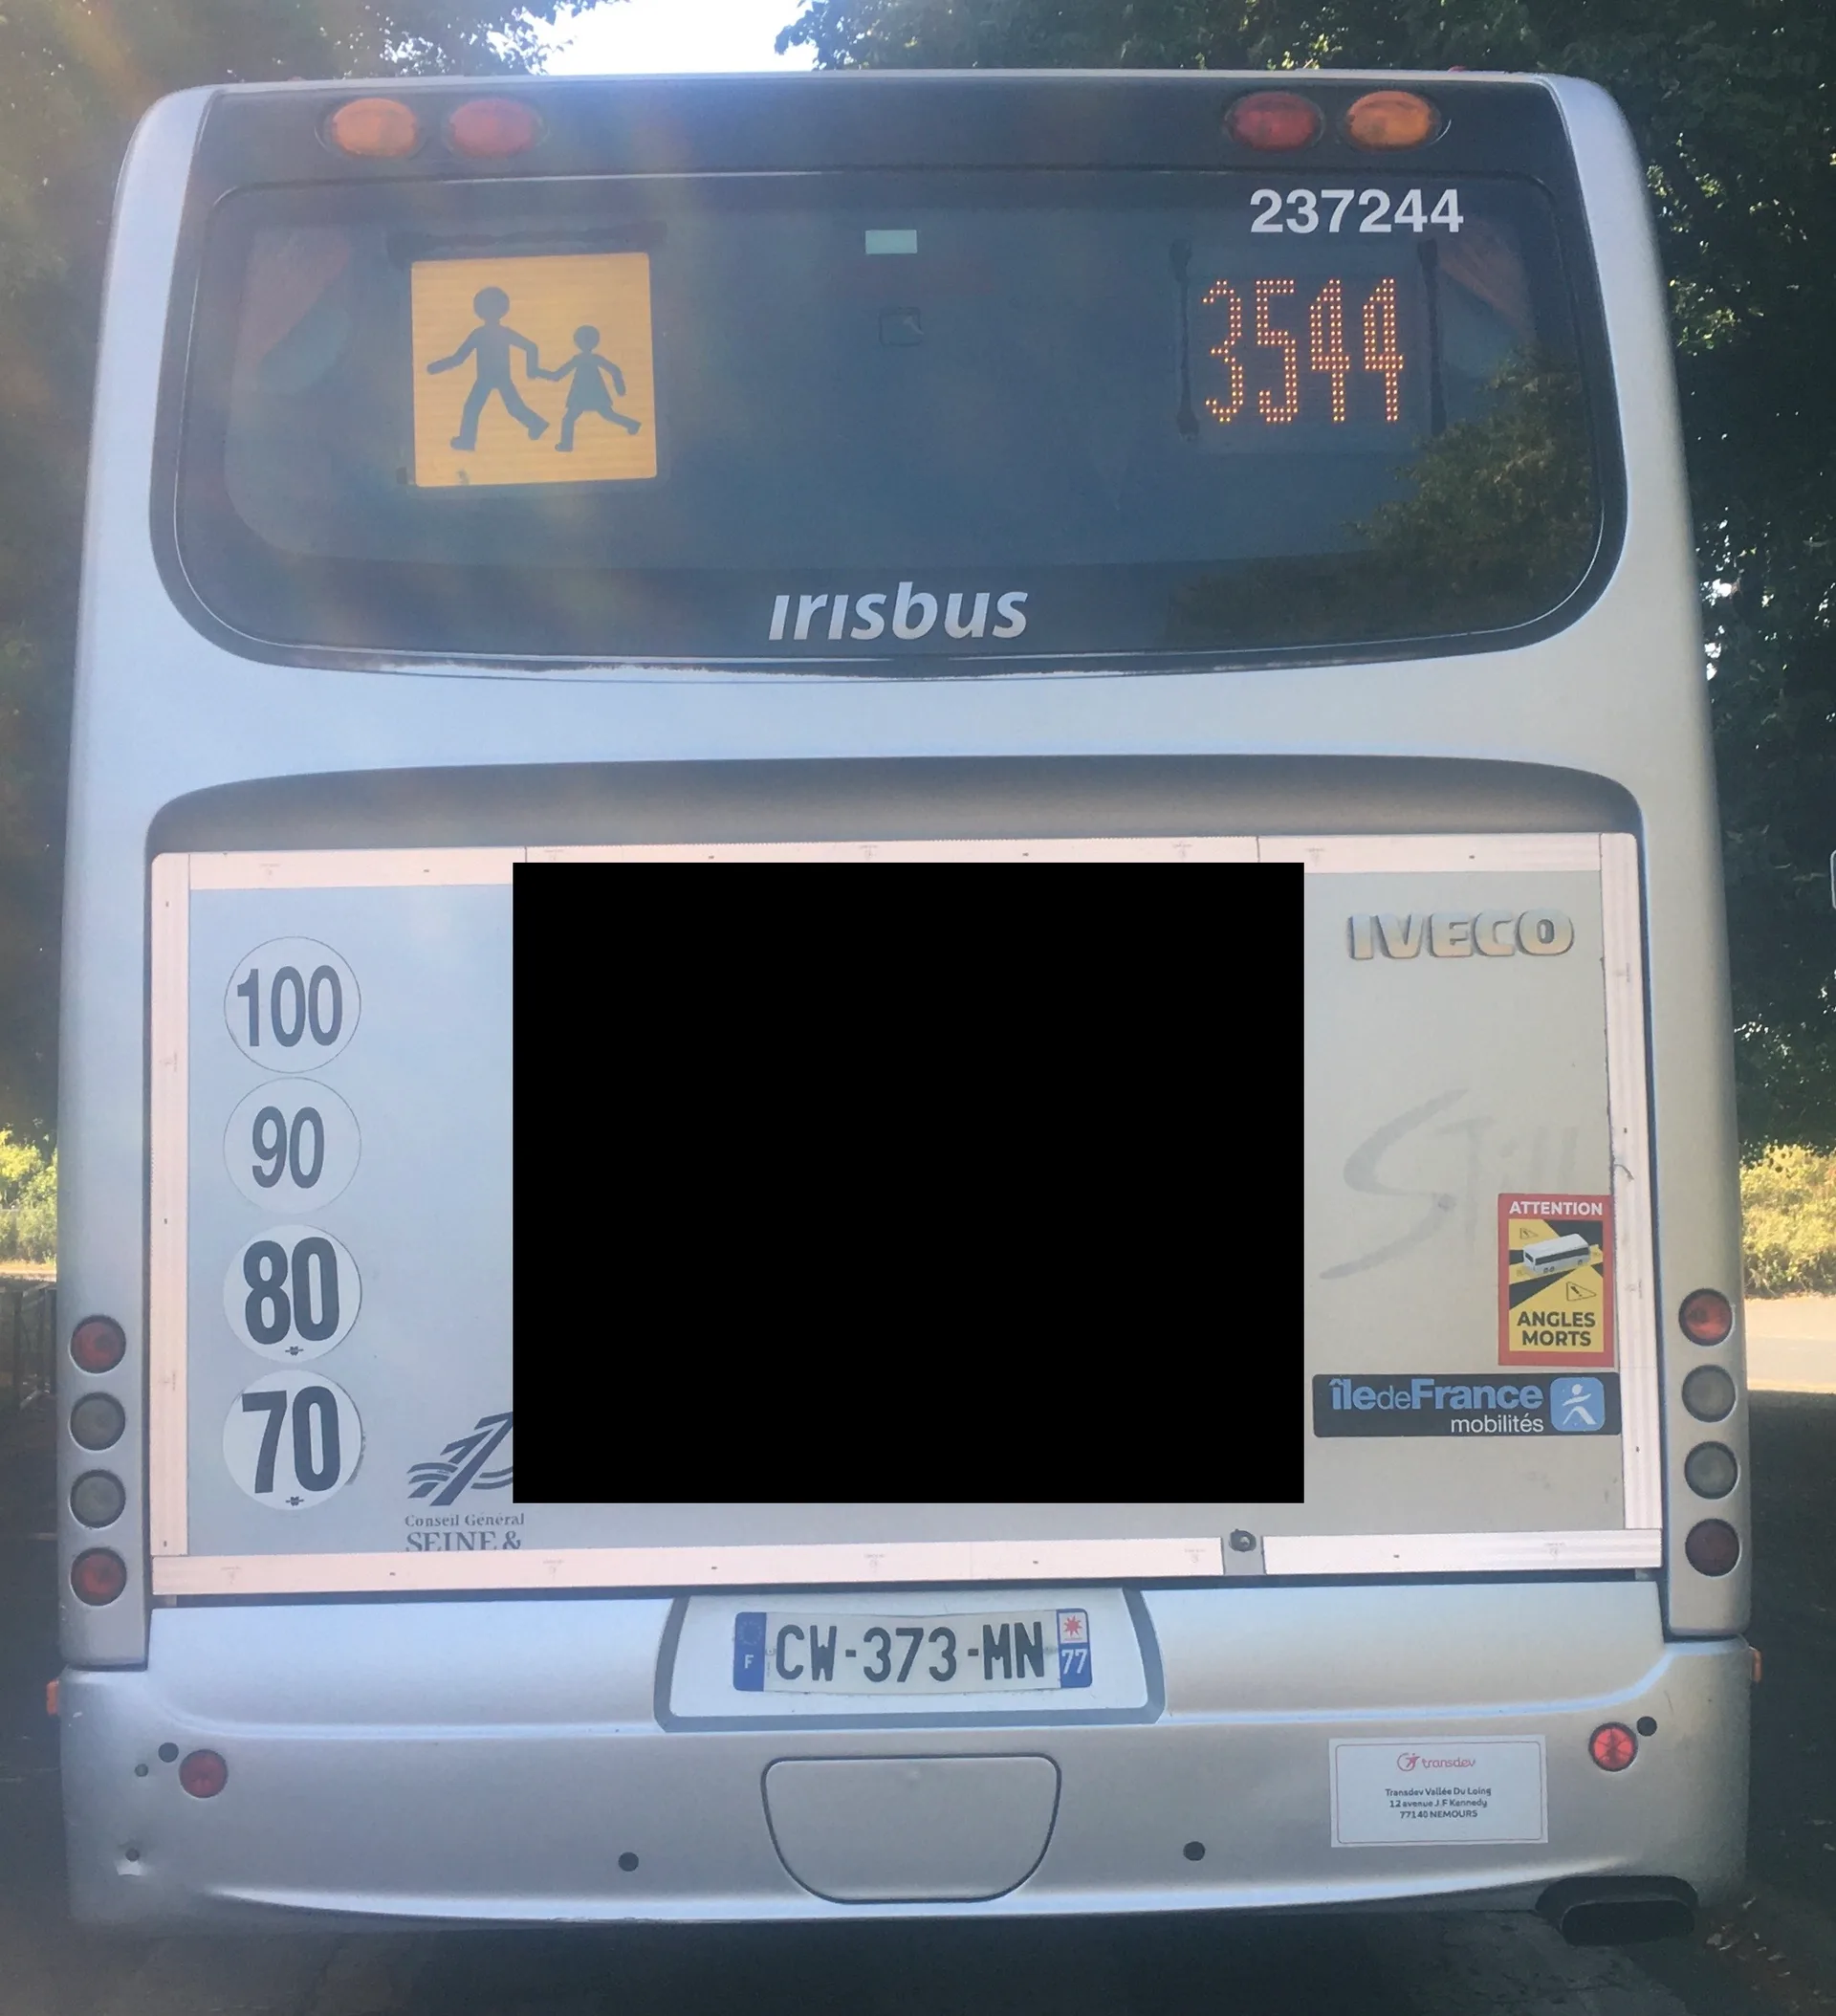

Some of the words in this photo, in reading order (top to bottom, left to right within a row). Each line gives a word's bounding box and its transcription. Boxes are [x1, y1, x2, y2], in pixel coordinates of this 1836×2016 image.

[1250, 189, 1464, 233] 237244
[1202, 278, 1405, 423] 3544
[1347, 908, 1575, 960] IVECO
[236, 964, 342, 1047] 100
[251, 1106, 325, 1189] 90
[1509, 1201, 1604, 1216] ATTENTION
[243, 1237, 340, 1345] 80
[1517, 1311, 1596, 1328] ANGLES
[1522, 1330, 1592, 1347] MORTS
[1451, 1413, 1544, 1434] mobilités
[242, 1386, 340, 1494] 70
[404, 1514, 460, 1527] Conseil
[405, 1531, 497, 1552] SEINE
[744, 1654, 754, 1669] F
[776, 1621, 1045, 1682] CW-373-MN
[1061, 1648, 1088, 1674] 77
[1422, 1756, 1475, 1768] transdev
[1386, 1788, 1424, 1797] Transdev
[1425, 1787, 1453, 1796] Vallée
[1467, 1786, 1492, 1797] Loing
[1449, 1798, 1488, 1808] Kennedy
[1400, 1810, 1429, 1819] 77140
[1430, 1809, 1478, 1818] NEMOURS
